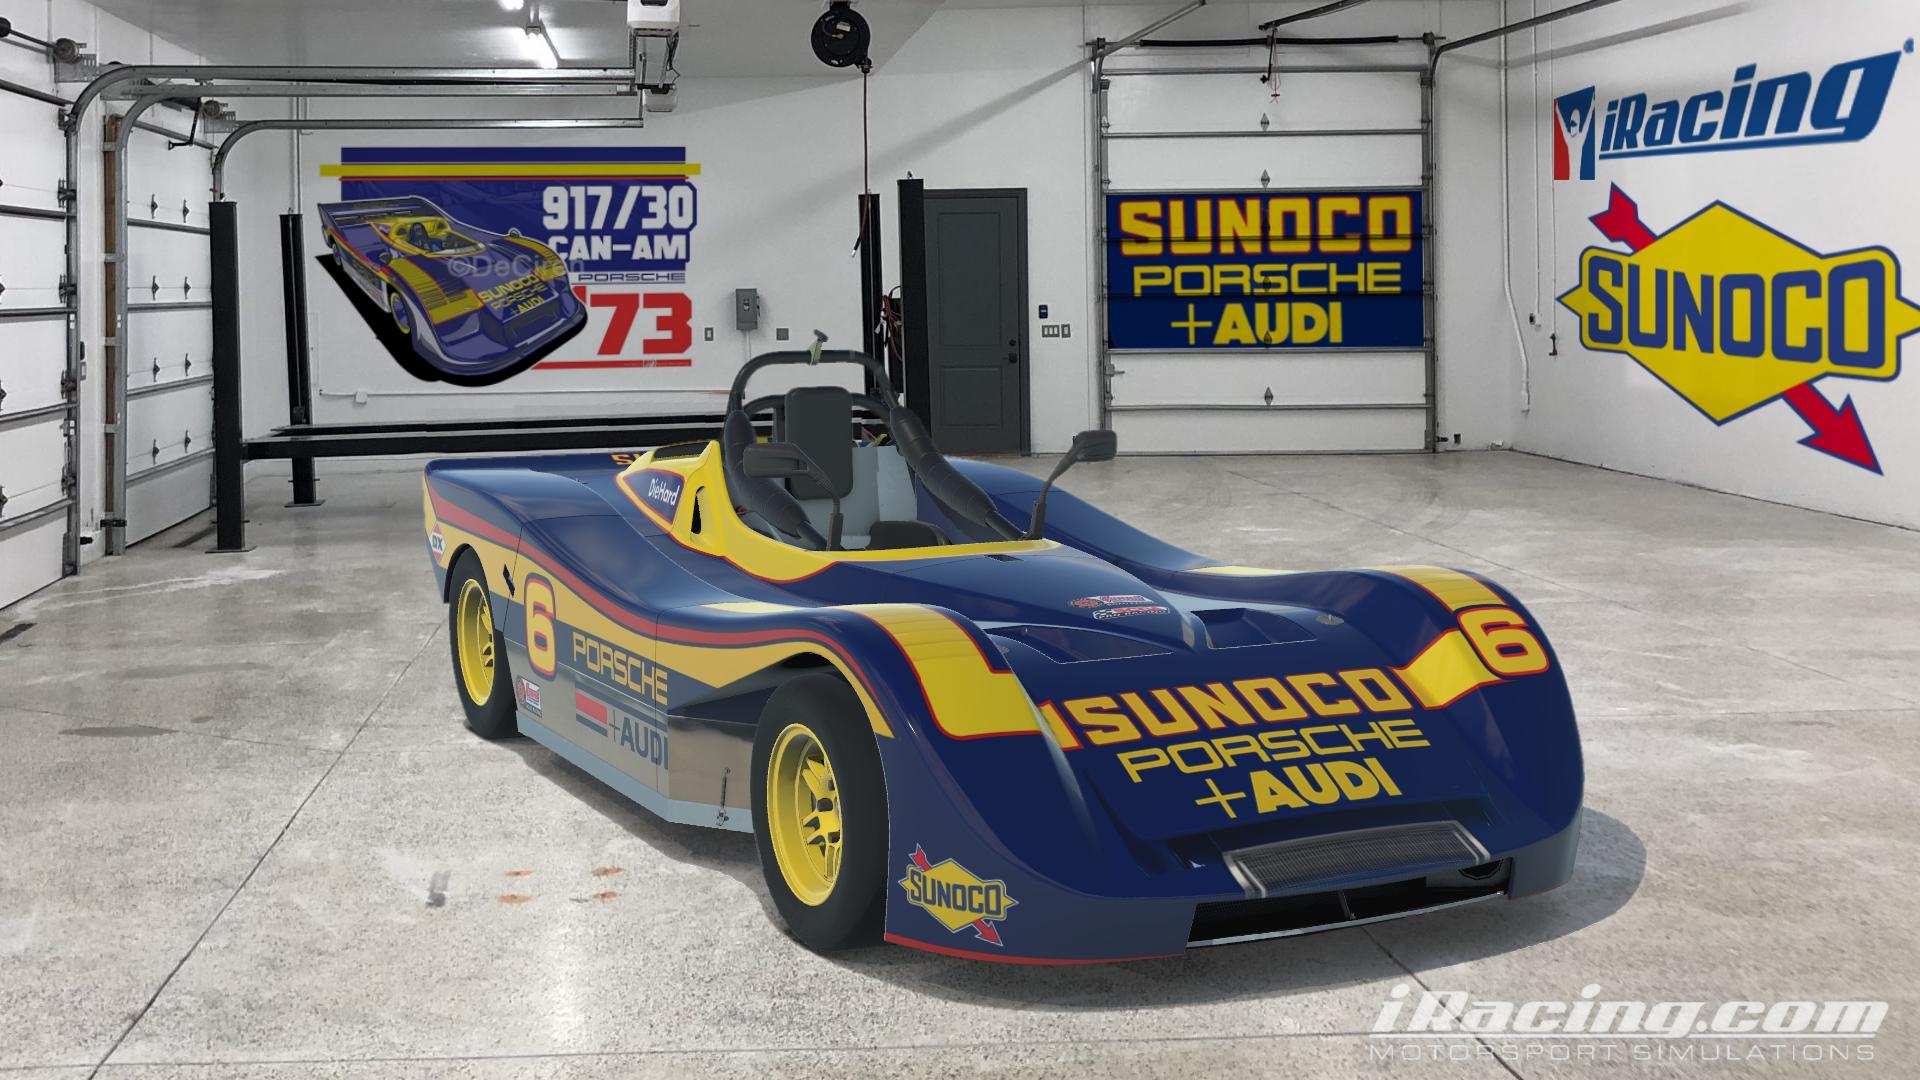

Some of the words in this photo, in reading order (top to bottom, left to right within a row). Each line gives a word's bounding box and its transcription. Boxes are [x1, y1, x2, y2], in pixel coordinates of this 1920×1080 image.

[1600, 51, 1902, 152] iRacing
[542, 185, 694, 230] 917/30
[1120, 196, 1412, 256] SUNOCO
[547, 234, 687, 261] CAN-AM
[478, 273, 541, 302] SUNOCO
[578, 272, 686, 282] PORSCHE
[1133, 262, 1402, 297] PORSCHE
[1588, 255, 1886, 369] SUNOCO
[647, 477, 681, 507] DieHard
[432, 534, 444, 551] DX
[524, 573, 557, 680] 6
[1457, 606, 1550, 677] 6
[572, 631, 668, 706] PORSCHE
[1068, 667, 1413, 746] SUNOCO
[1116, 718, 1430, 783] PORSCHE
[909, 870, 1002, 916] SUNOCO
